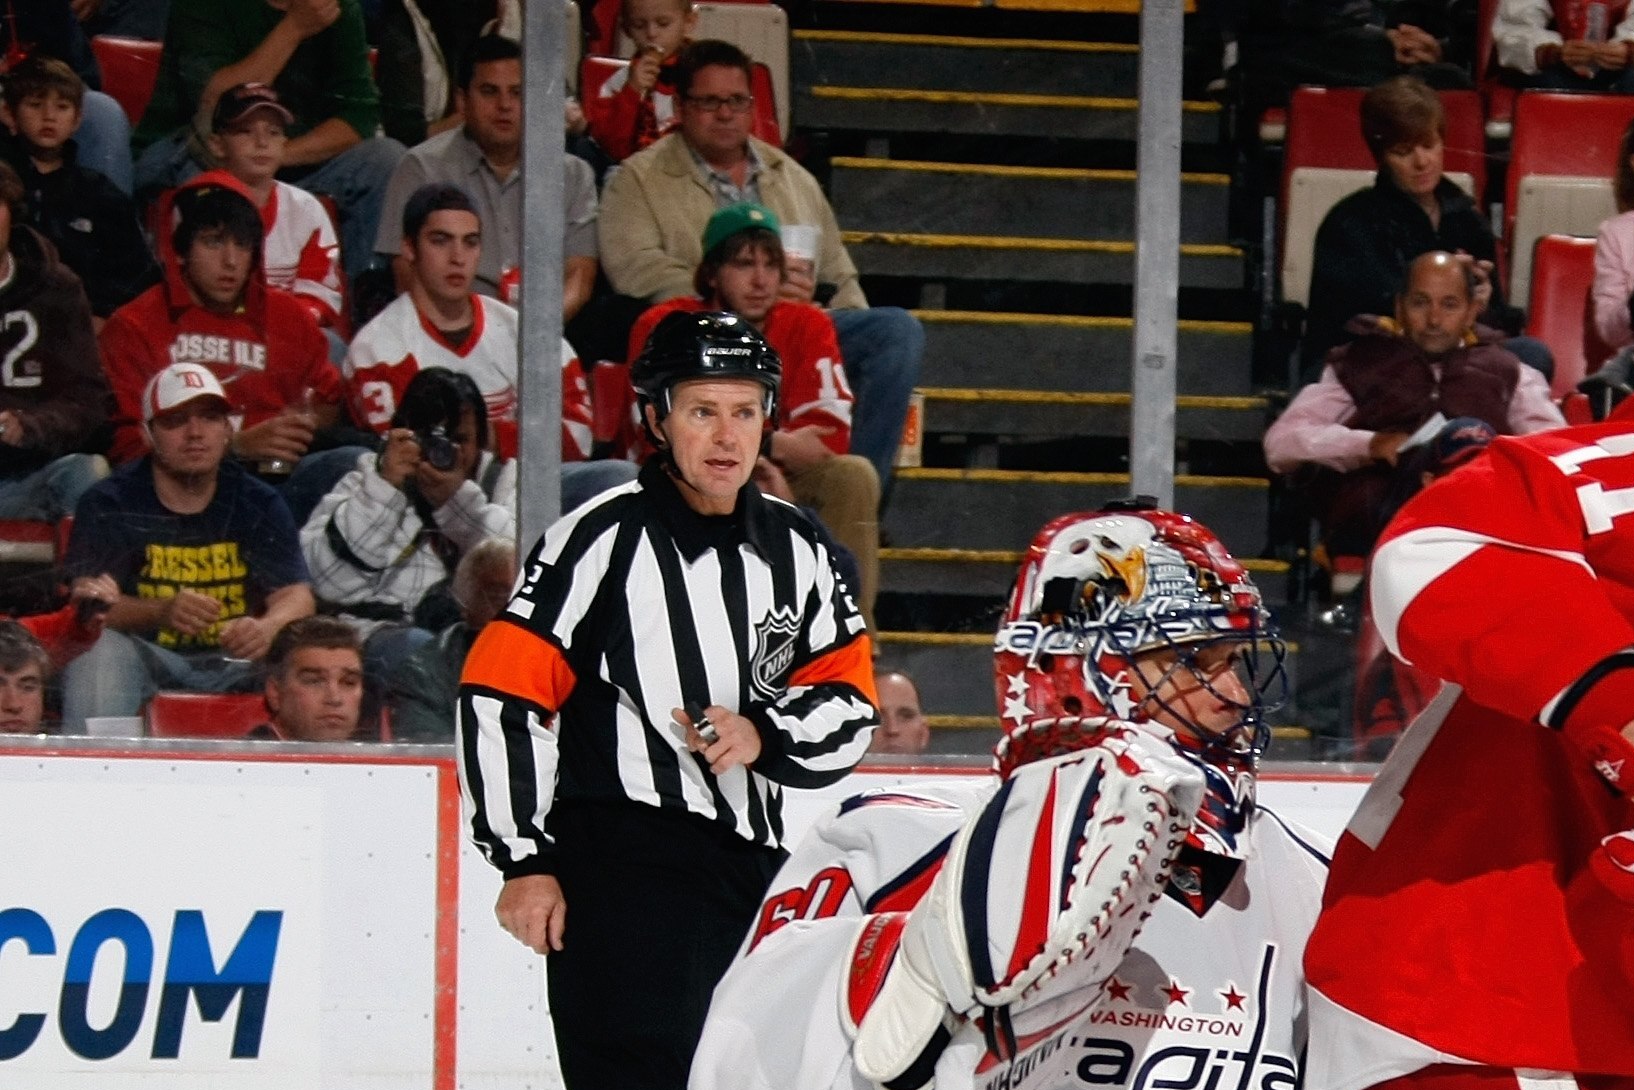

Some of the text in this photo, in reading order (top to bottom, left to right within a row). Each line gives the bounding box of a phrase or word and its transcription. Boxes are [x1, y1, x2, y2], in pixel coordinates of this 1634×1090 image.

[0, 310, 42, 387] 2
[170, 334, 230, 362] OSSE
[706, 347, 752, 357] BAUER
[764, 642, 796, 681] NHL
